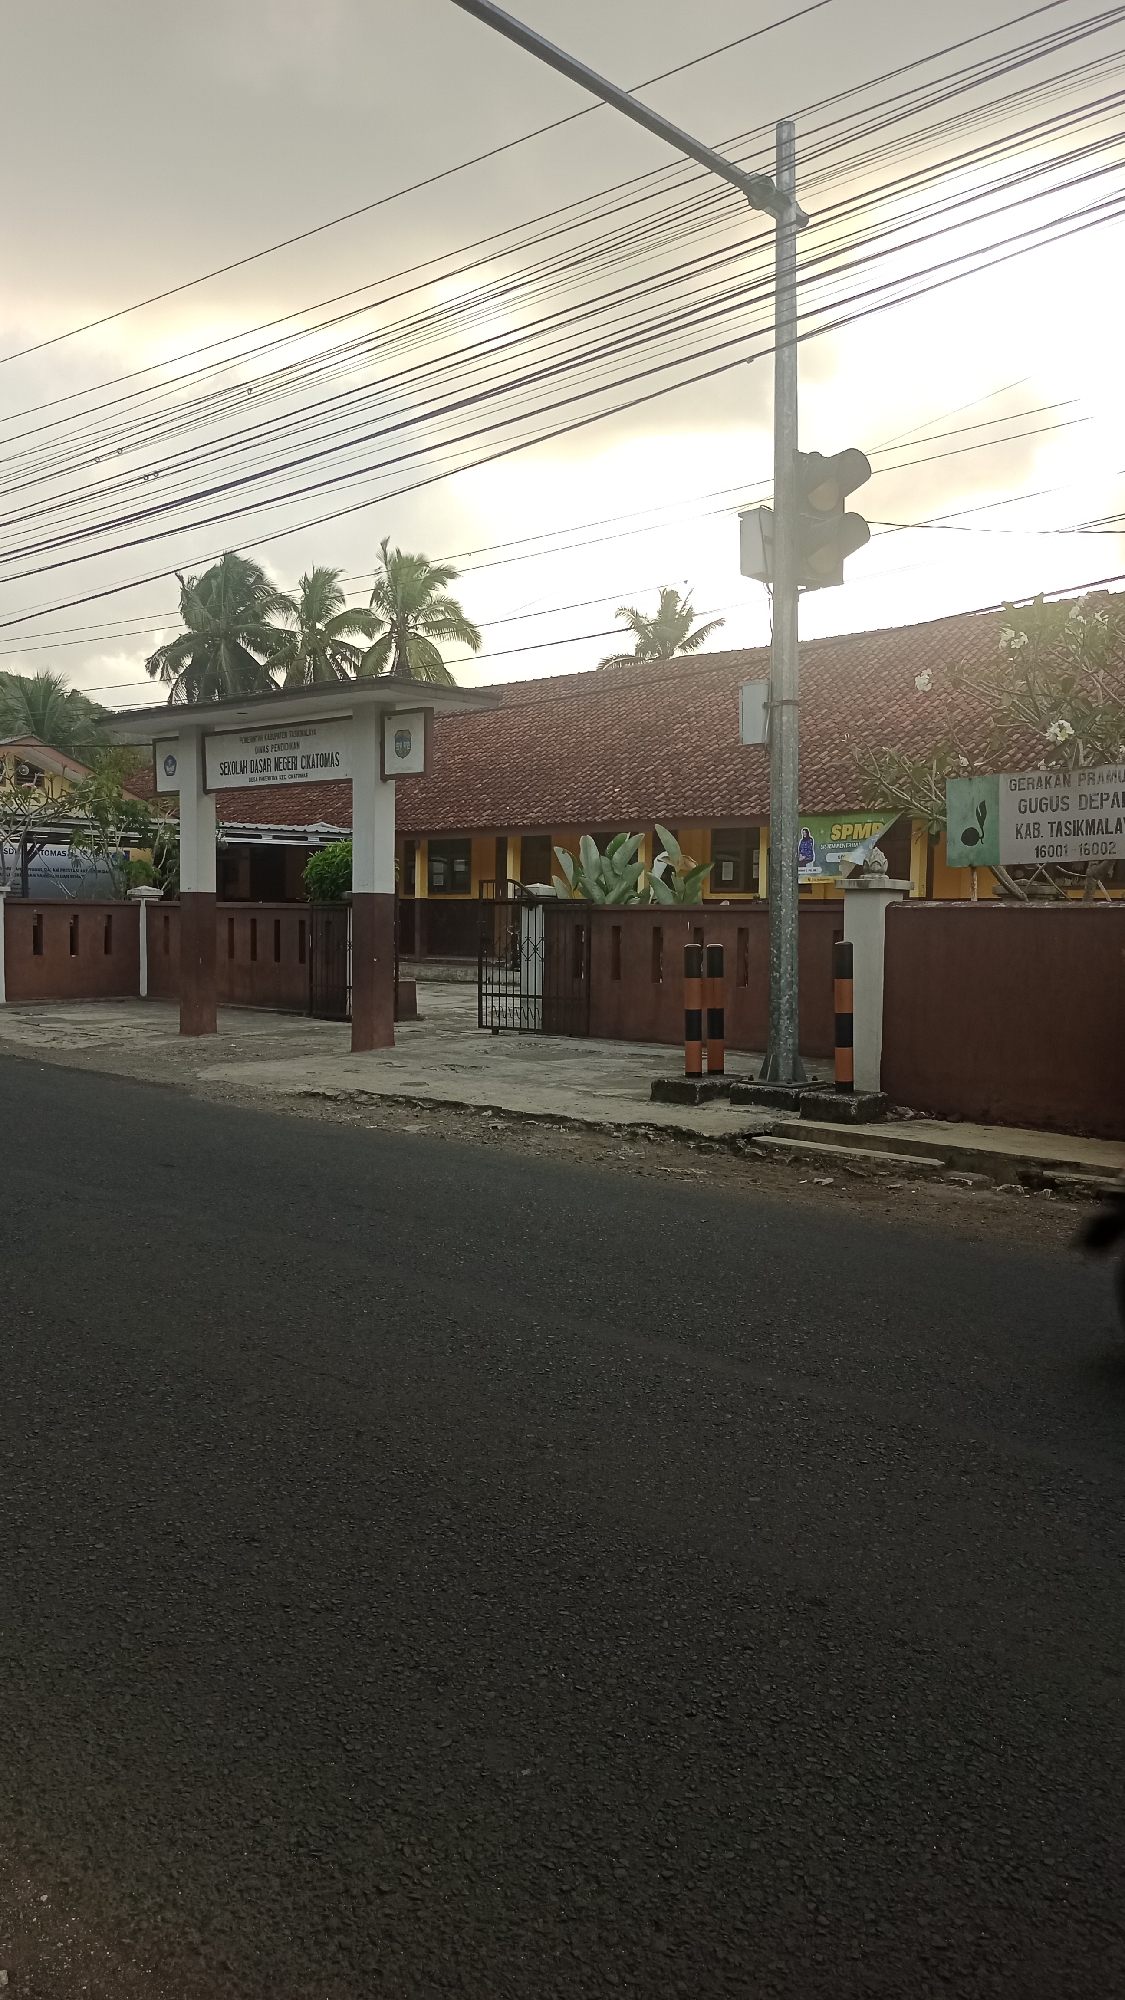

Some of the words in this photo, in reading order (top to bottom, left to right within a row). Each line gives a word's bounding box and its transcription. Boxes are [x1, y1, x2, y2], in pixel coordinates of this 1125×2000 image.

[254, 745, 270, 754] DINAS
[270, 741, 300, 752] PENDIDIKAN
[220, 760, 248, 776] SEKOLAH
[250, 758, 272, 774] DASAR
[274, 756, 298, 772] NEGERI
[300, 752, 340, 770] CIKATOMAS
[1009, 772, 1072, 792] GERAKAN
[1018, 795, 1070, 814] GUGUS
[1016, 822, 1044, 840] KAB.
[1034, 844, 1068, 858] 16001
[1078, 841, 1117, 857] 16002
